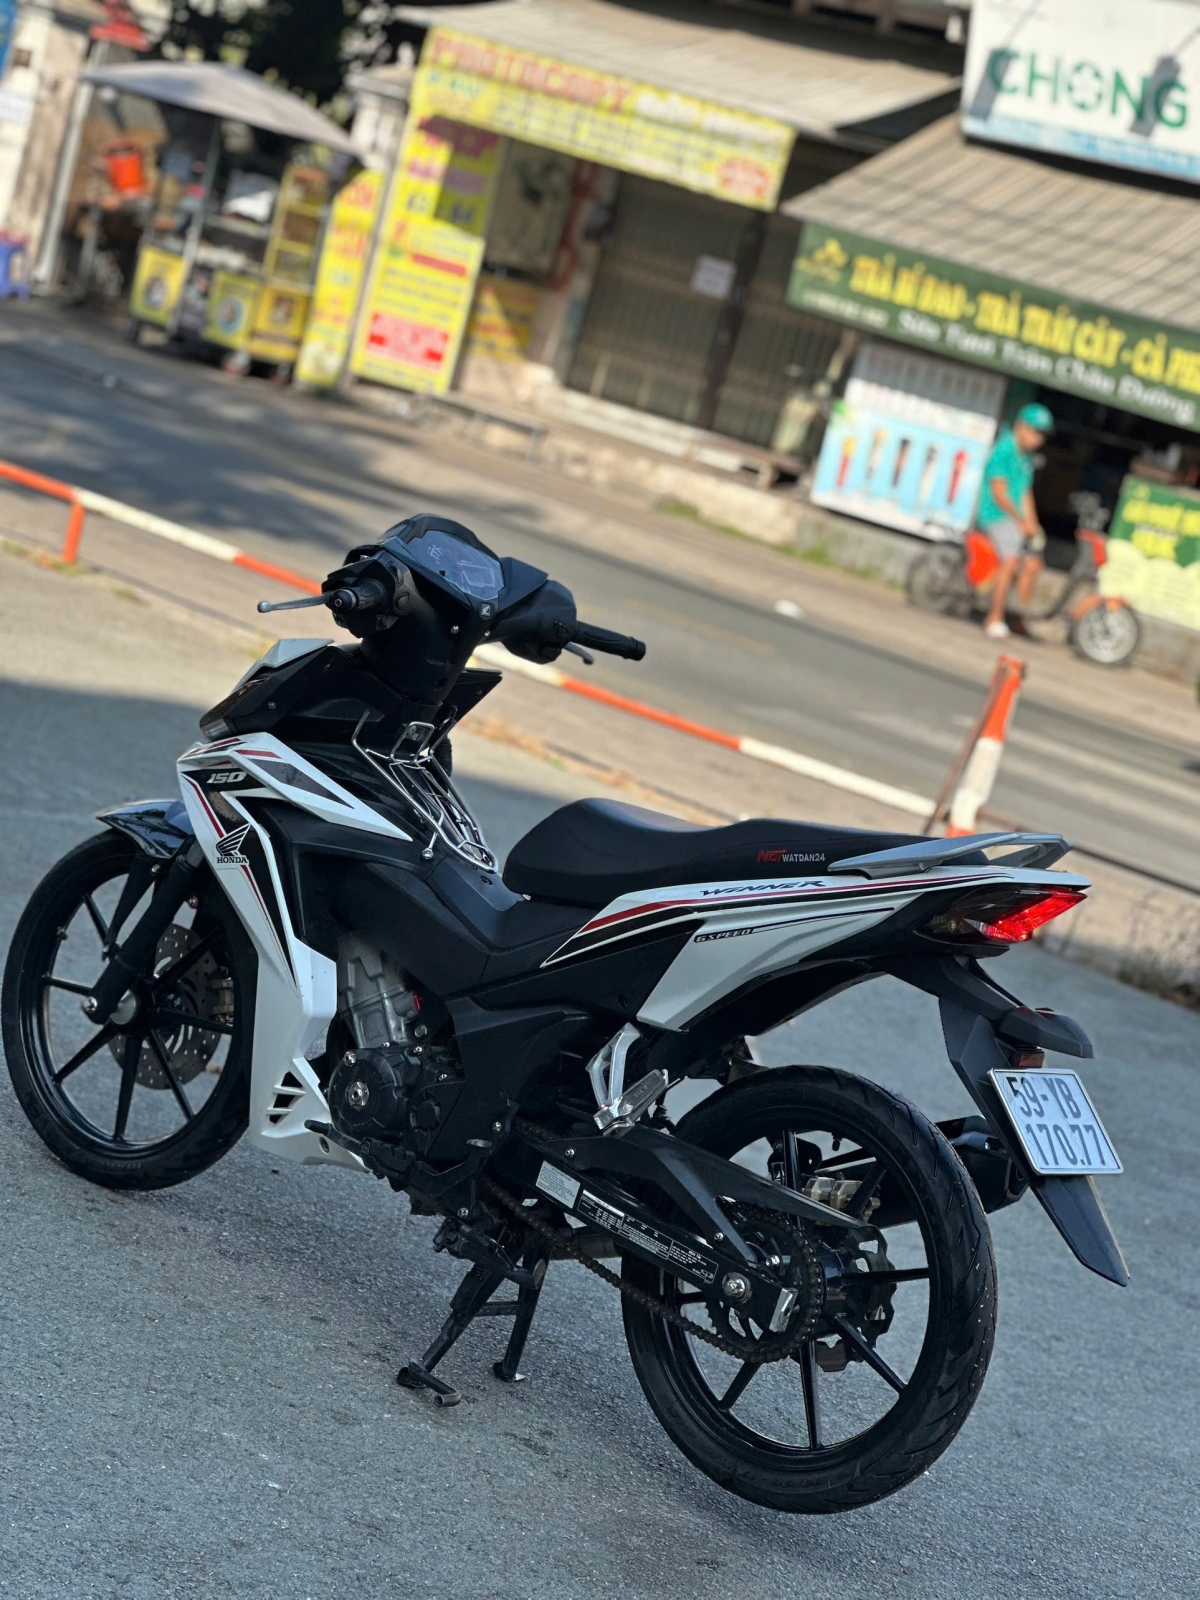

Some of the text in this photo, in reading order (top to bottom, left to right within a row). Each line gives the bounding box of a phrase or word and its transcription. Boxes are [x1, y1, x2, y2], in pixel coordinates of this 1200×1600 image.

[988, 47, 1188, 129] CHONG
[206, 771, 247, 784] 150
[216, 856, 248, 864] HONDA
[782, 852, 826, 863] WATDAN24
[700, 880, 826, 896] WINNER
[1005, 1076, 1082, 1119] 59-YB
[1025, 1123, 1106, 1166] 170.77
